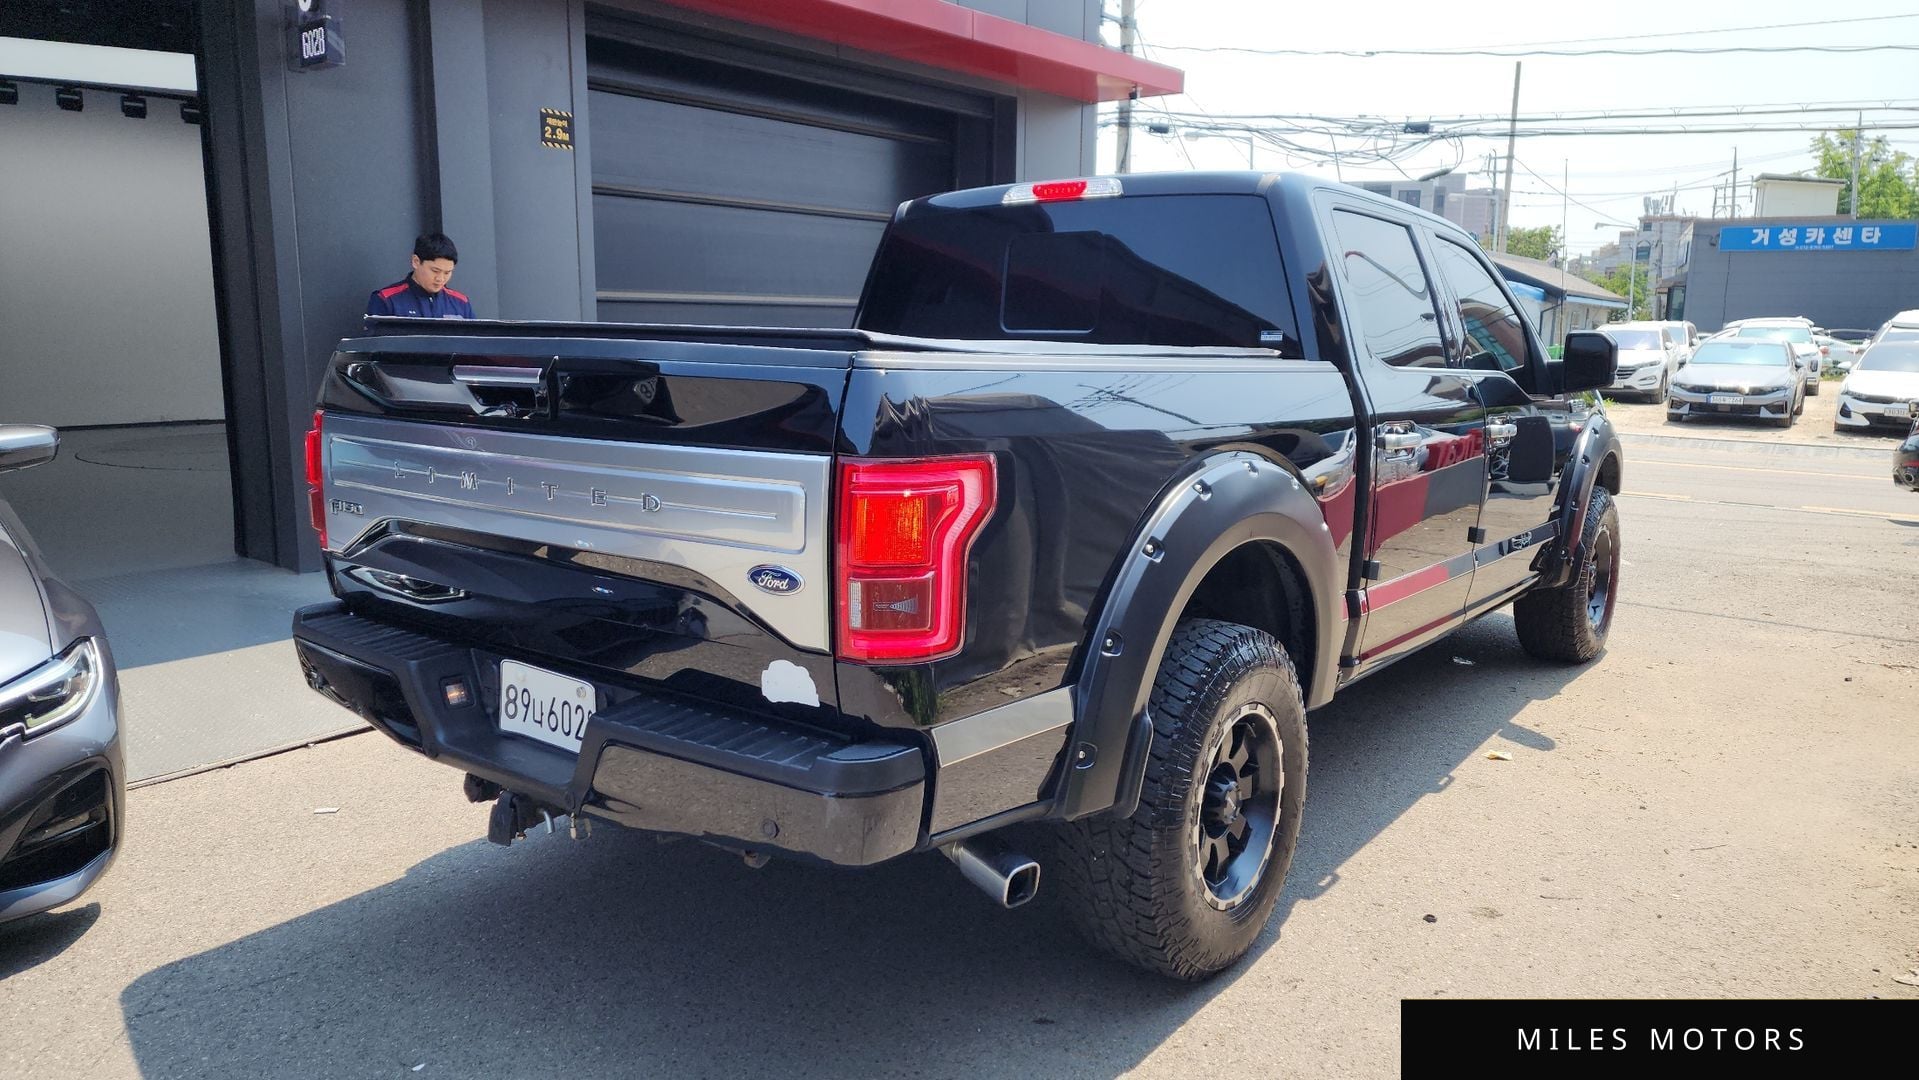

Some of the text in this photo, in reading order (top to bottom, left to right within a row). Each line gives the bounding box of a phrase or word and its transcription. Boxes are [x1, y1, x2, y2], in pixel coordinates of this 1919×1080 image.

[302, 27, 325, 58] 6028
[1752, 227, 1881, 246] 거성카센타
[394, 461, 662, 512] LIMITED
[758, 570, 789, 589] Ford
[505, 684, 594, 740] 89나602
